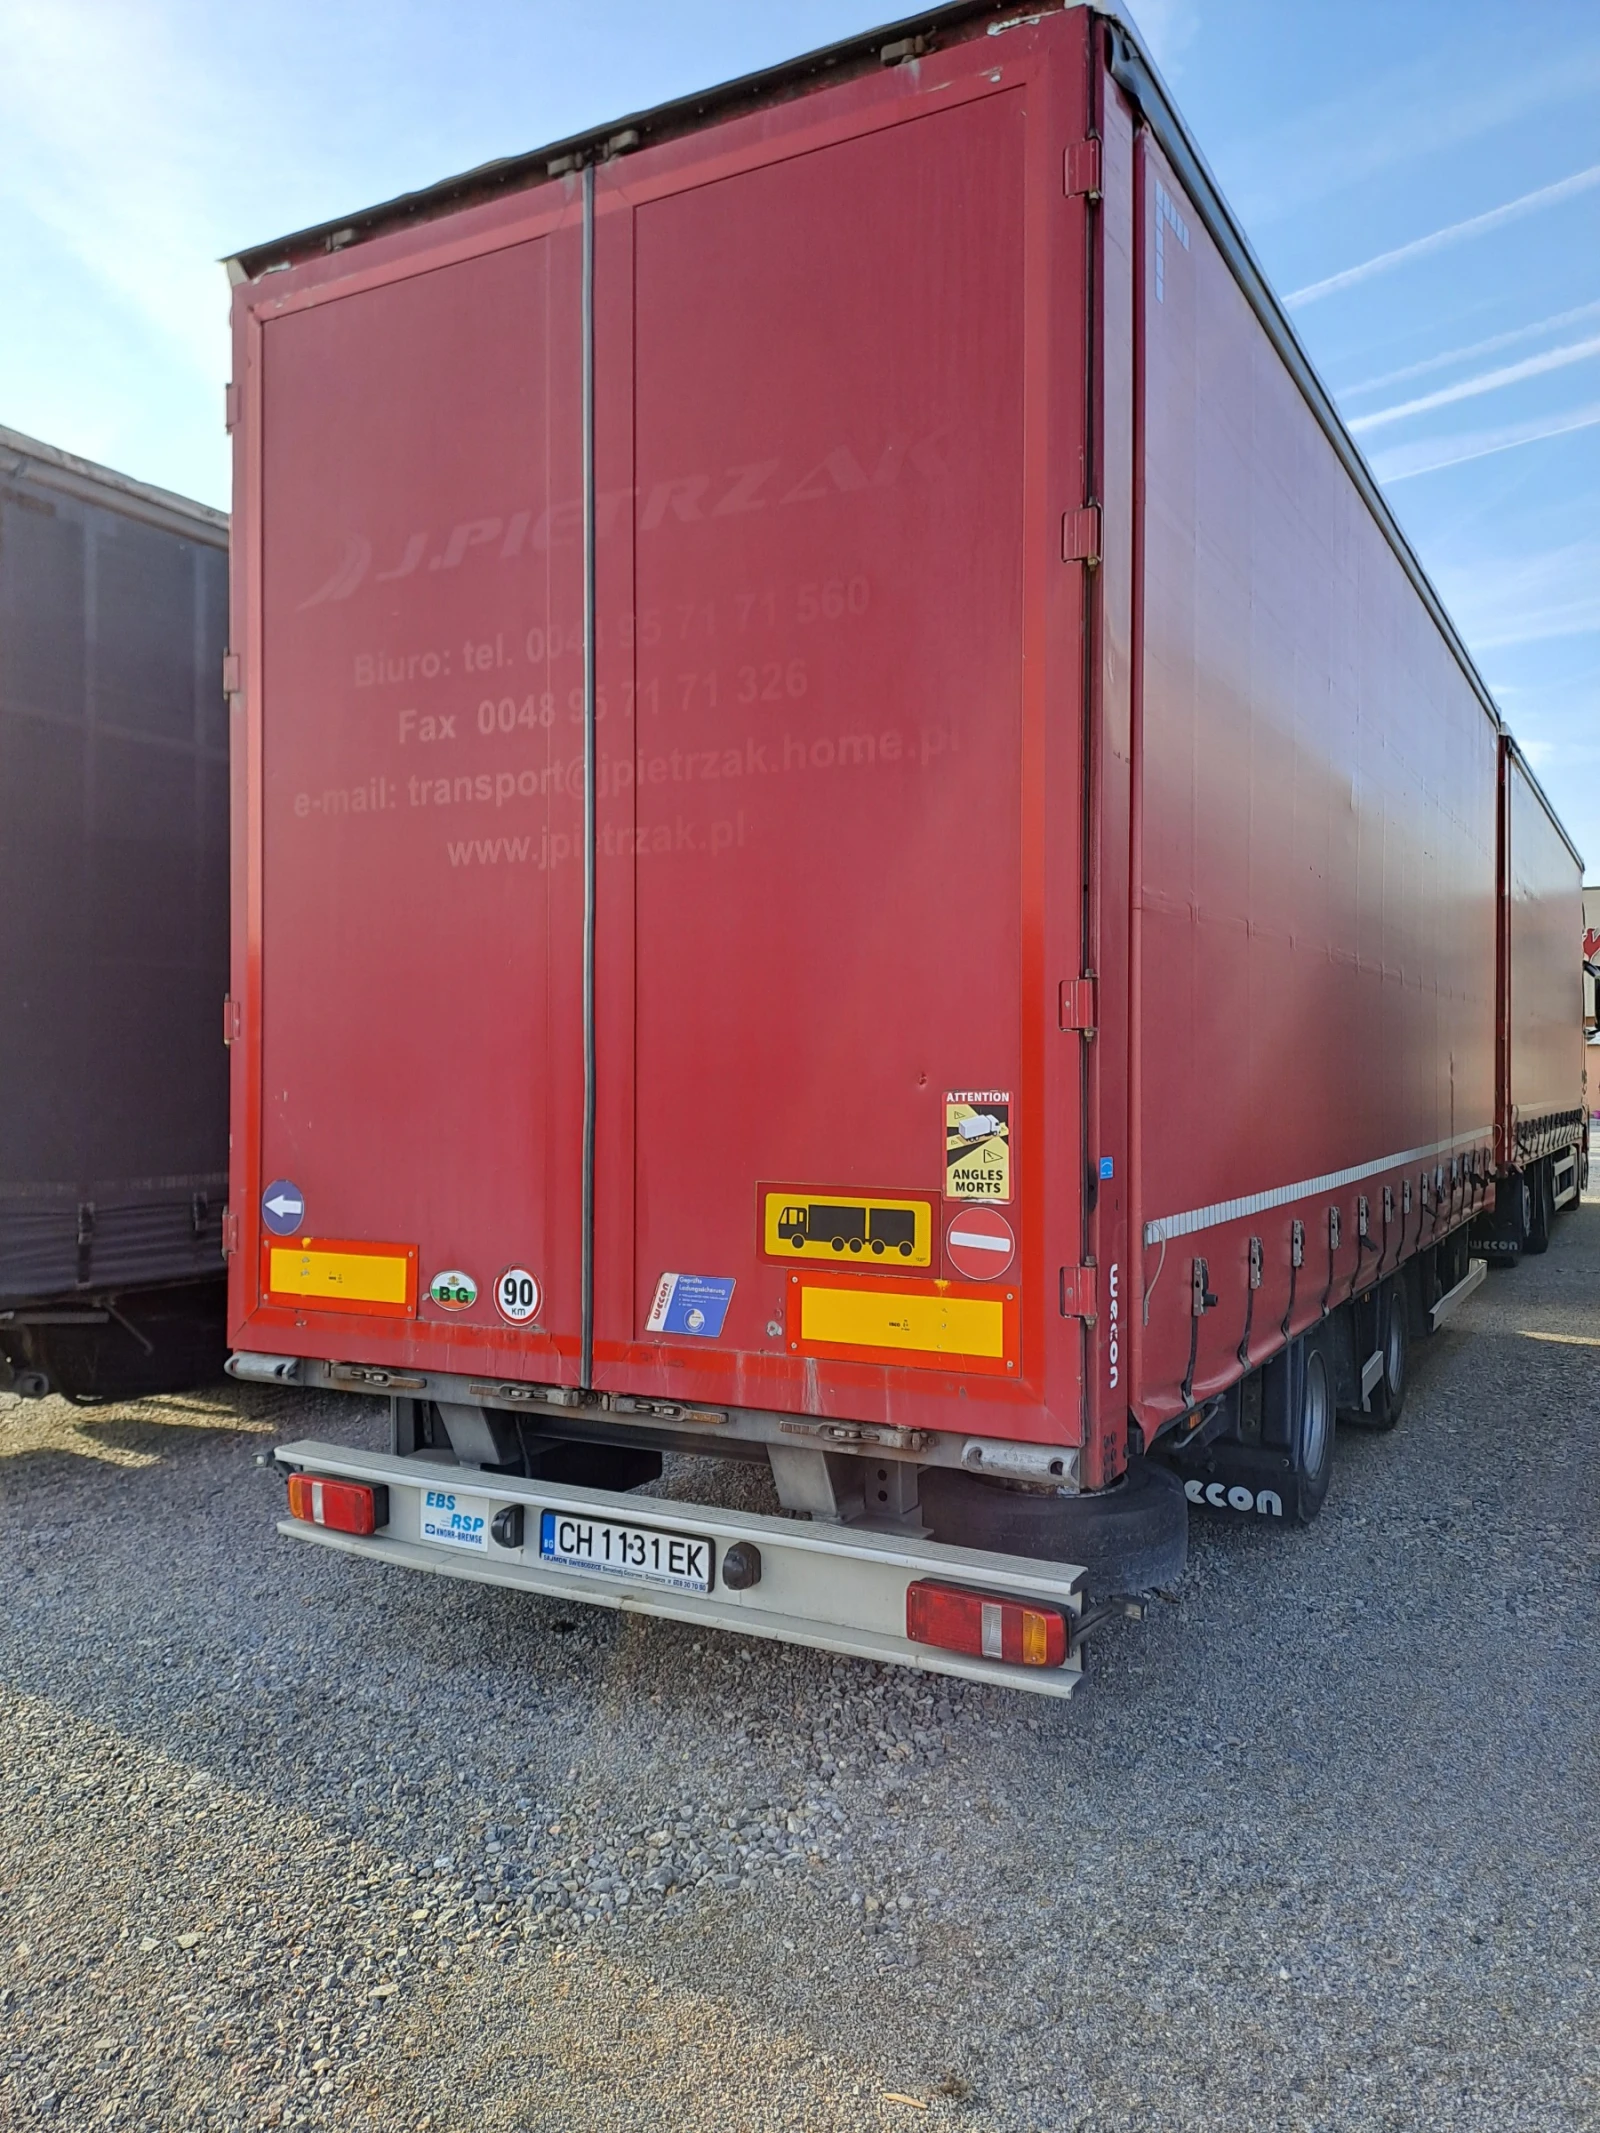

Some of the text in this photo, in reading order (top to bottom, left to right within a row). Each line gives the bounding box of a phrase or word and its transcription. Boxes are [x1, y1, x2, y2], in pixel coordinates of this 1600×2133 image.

[354, 650, 450, 688] Biuro:
[464, 633, 513, 673] tel.
[617, 608, 662, 648] 95
[676, 602, 716, 641] 71
[735, 591, 776, 634] 71
[797, 575, 870, 624] 560
[399, 708, 456, 744] Fax
[477, 692, 556, 735] 0048
[620, 677, 659, 718] 71
[678, 669, 718, 712] 71
[737, 657, 808, 703] 326
[294, 776, 397, 818] e-mail:
[447, 810, 745, 870] www.jpitrzak.pl
[946, 1091, 1009, 1103] ATTENTION
[953, 1169, 1003, 1181] ANGLES
[955, 1182, 1001, 1194] MORTS
[1469, 1240, 1518, 1251] wecon
[504, 1278, 533, 1307] 90
[653, 1282, 670, 1320] wecon
[426, 1491, 456, 1511] EBS
[1183, 1479, 1283, 1517] econ
[451, 1513, 485, 1533] RSP
